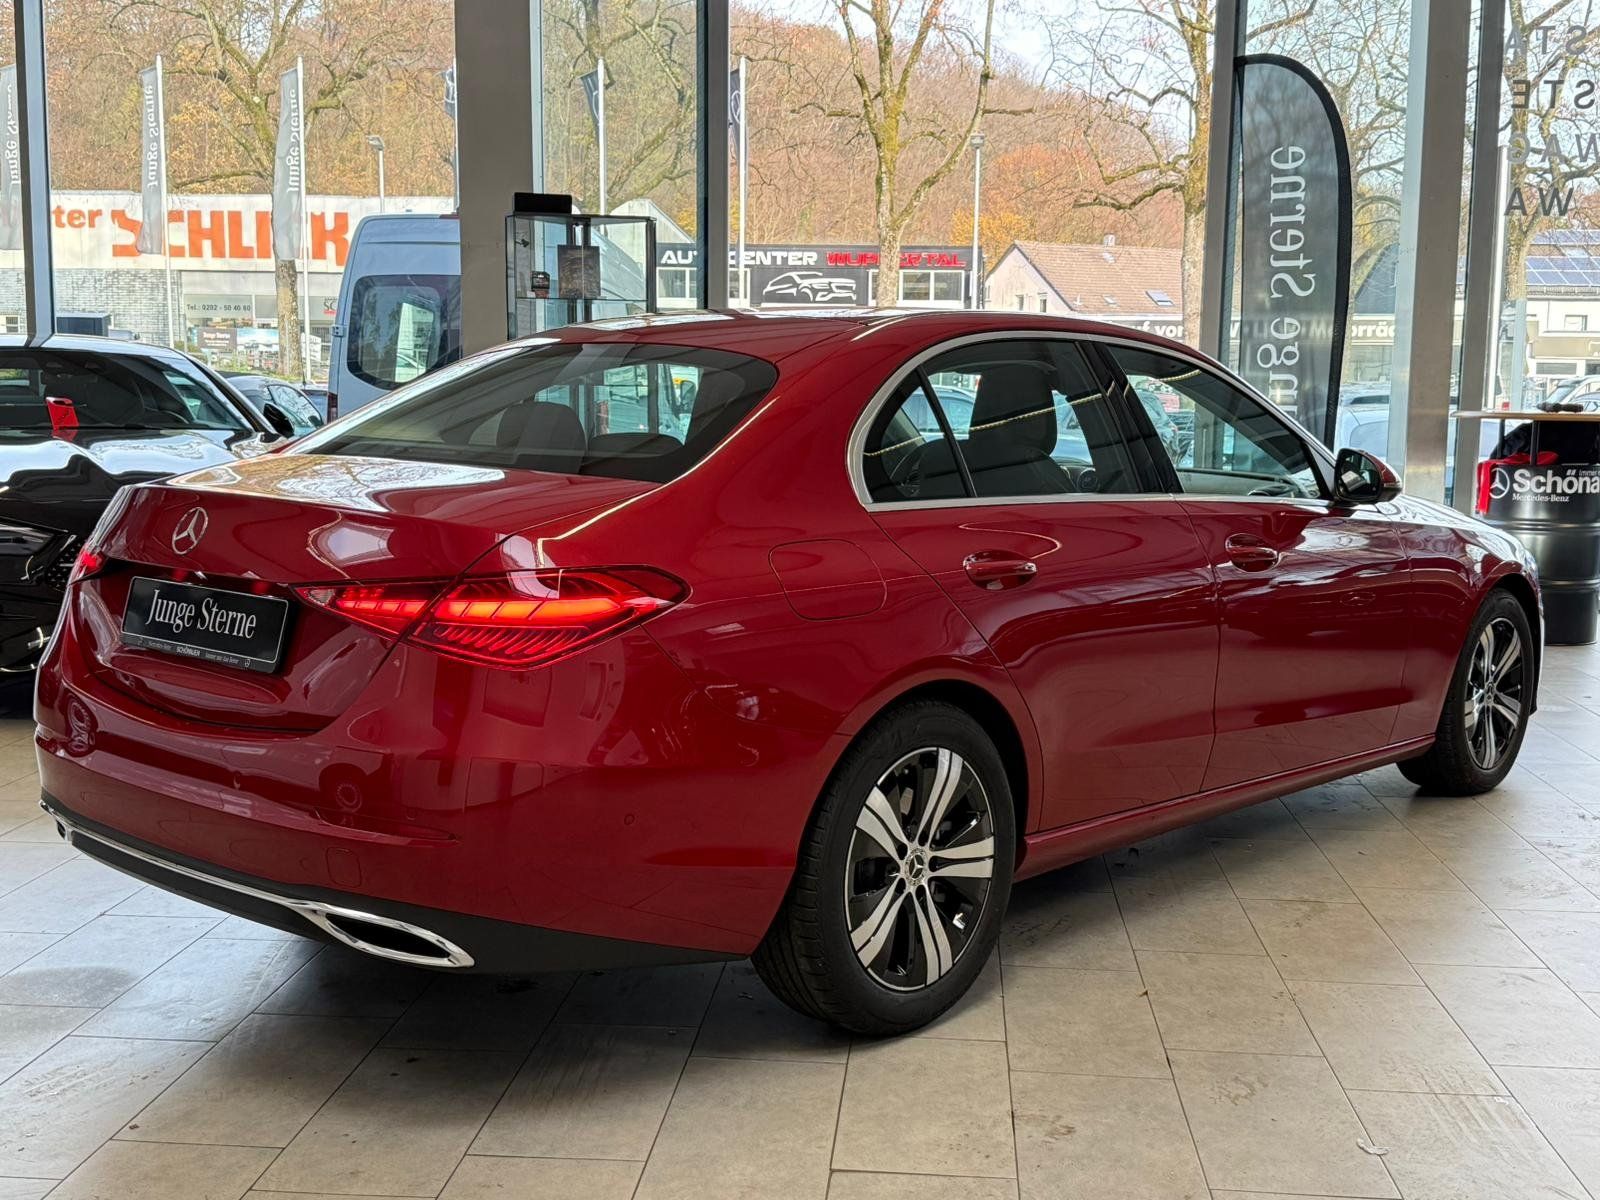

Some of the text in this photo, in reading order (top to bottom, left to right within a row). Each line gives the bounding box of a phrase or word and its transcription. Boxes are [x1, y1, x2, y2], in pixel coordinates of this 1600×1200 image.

[111, 209, 349, 266] SHLIK
[660, 250, 698, 264] AU
[826, 252, 966, 267] WUPRTAL
[1513, 468, 1600, 494] Schöna
[1512, 493, 1570, 502] Mercedes-Benz
[145, 589, 257, 639] Junge Sterne
